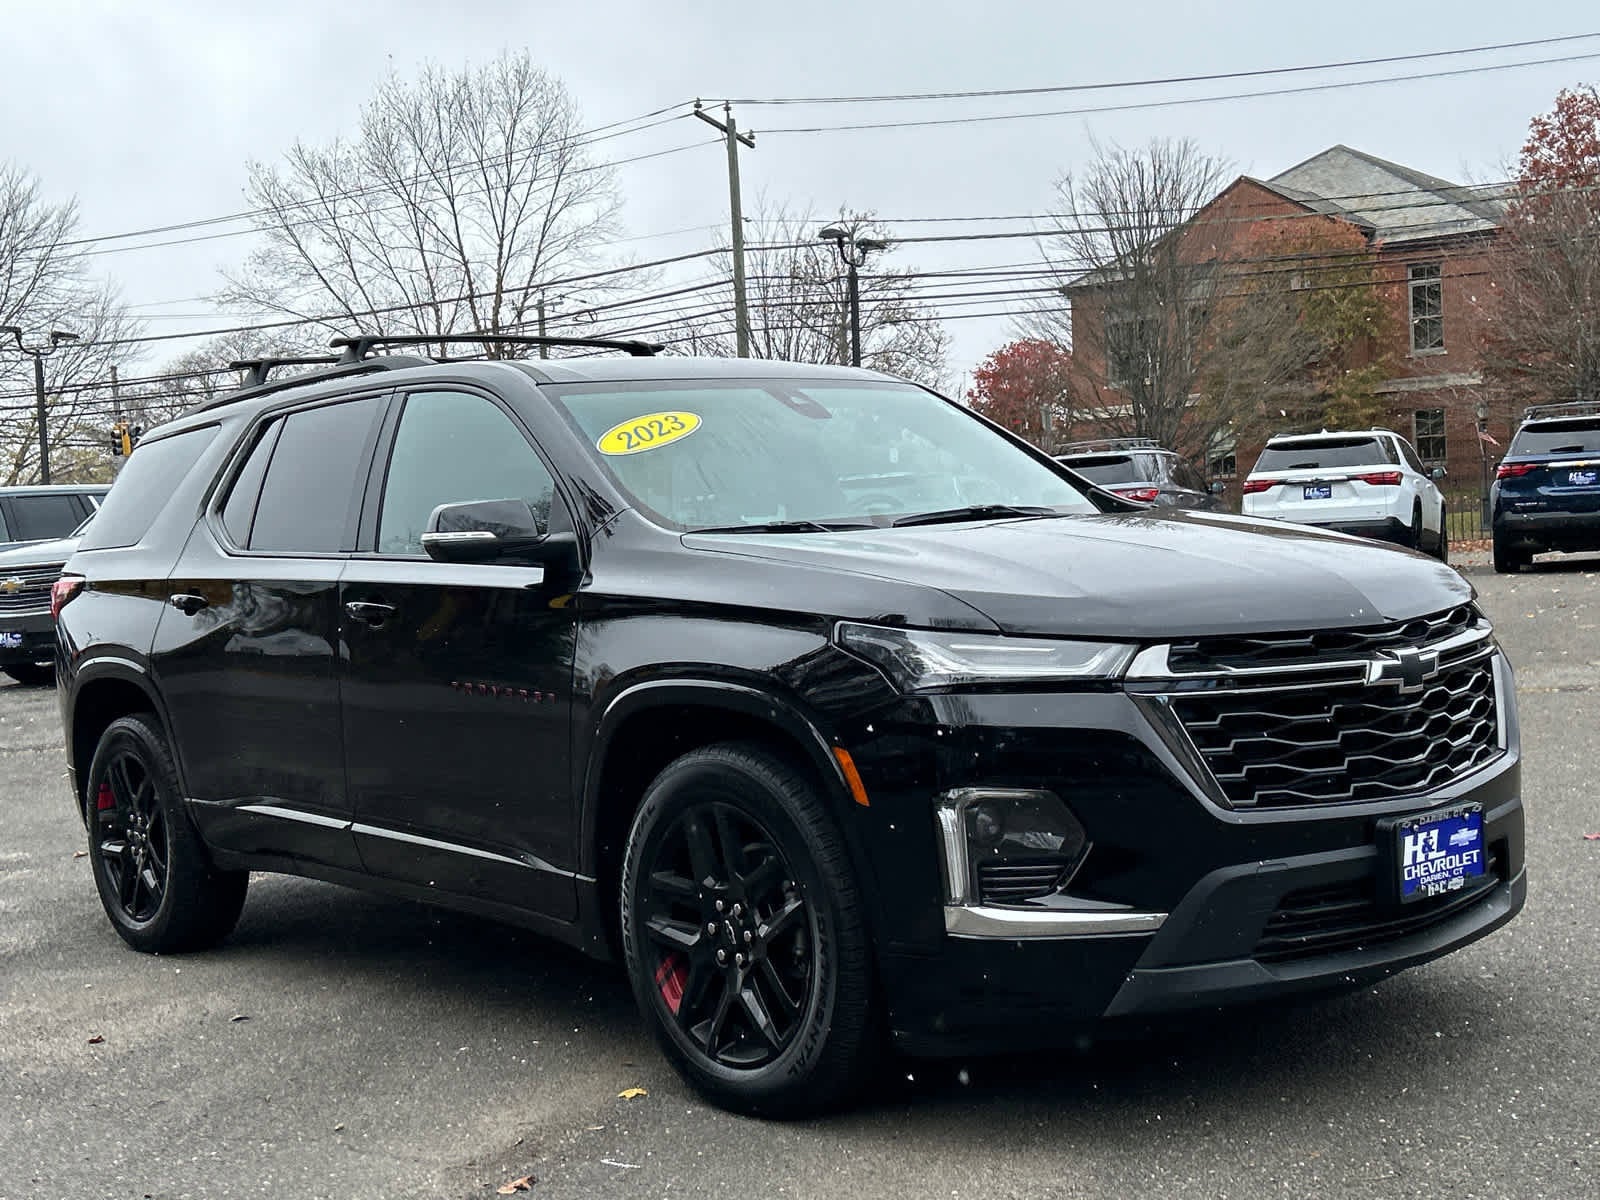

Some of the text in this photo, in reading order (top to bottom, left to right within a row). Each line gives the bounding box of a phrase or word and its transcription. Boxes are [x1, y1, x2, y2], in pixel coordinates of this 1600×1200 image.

[616, 415, 686, 450] 2023
[1403, 829, 1446, 867] H&L
[1404, 849, 1480, 881] CHEVROLET
[1453, 867, 1464, 876] CT
